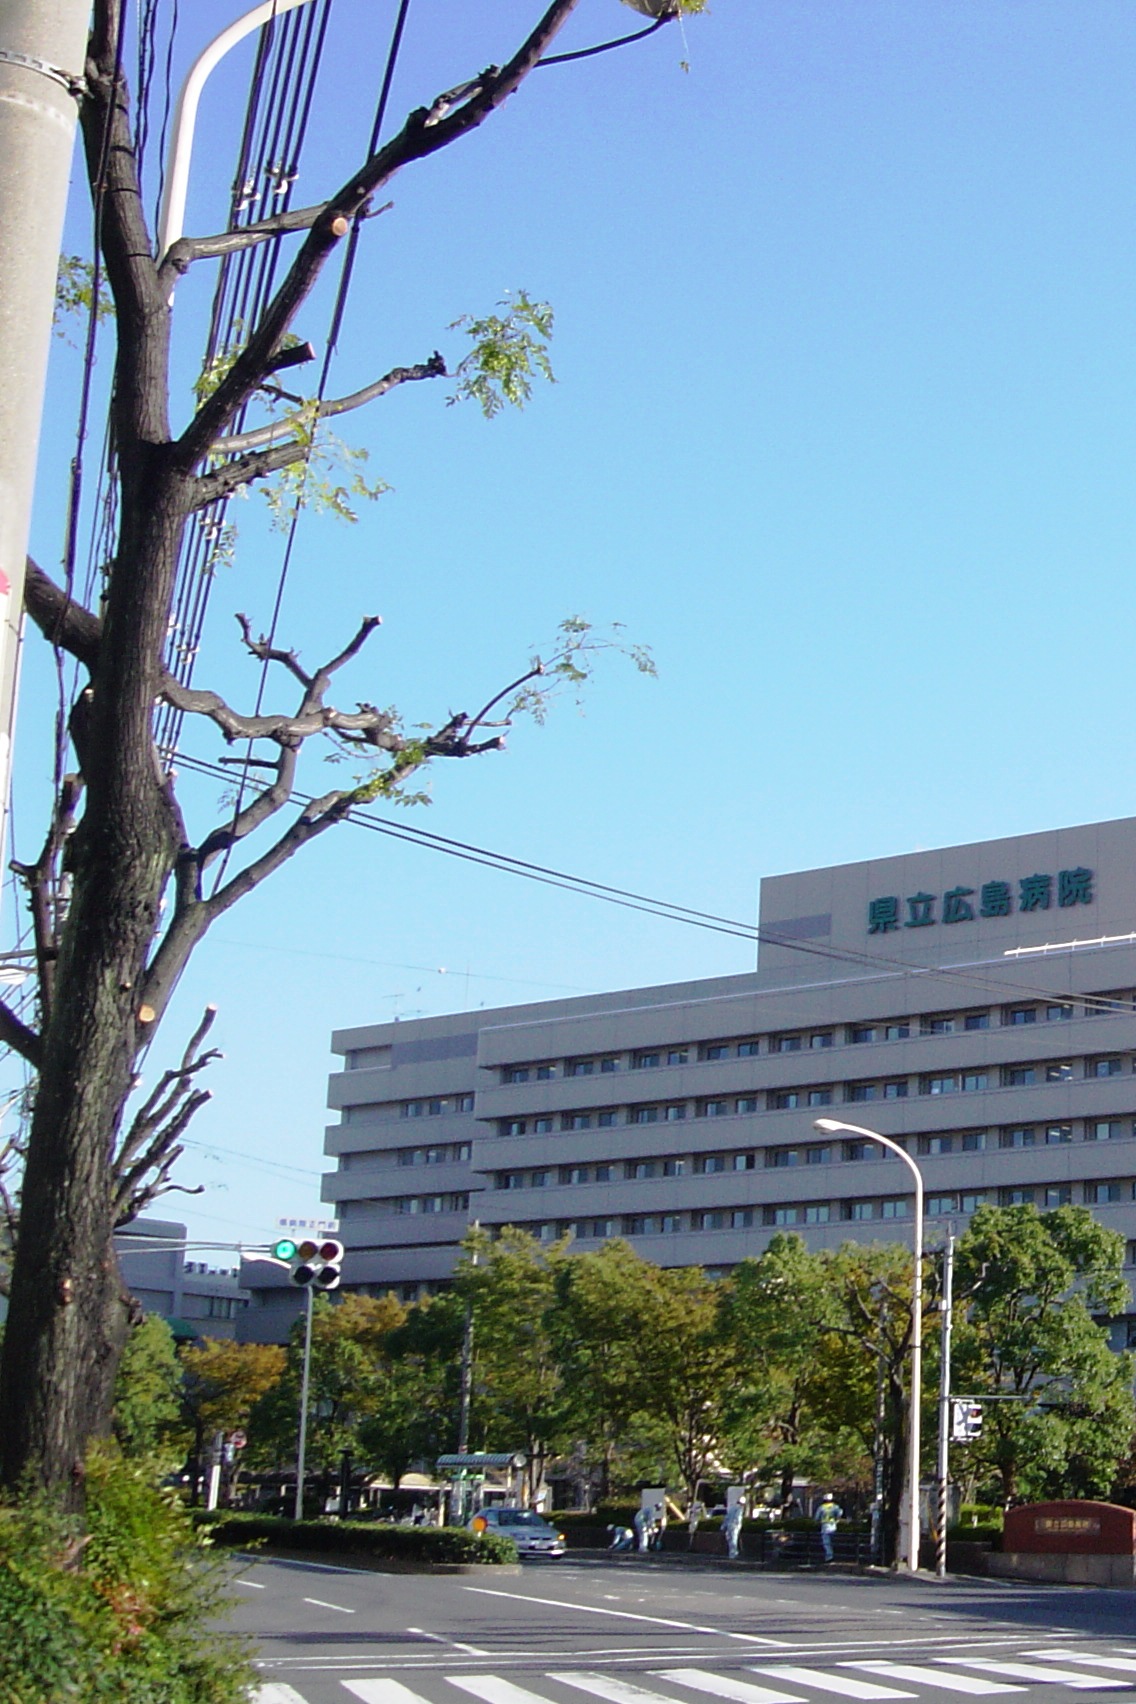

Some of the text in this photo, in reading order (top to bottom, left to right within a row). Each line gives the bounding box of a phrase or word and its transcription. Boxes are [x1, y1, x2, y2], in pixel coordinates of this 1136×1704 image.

[867, 866, 1094, 934] 県立広島病院
